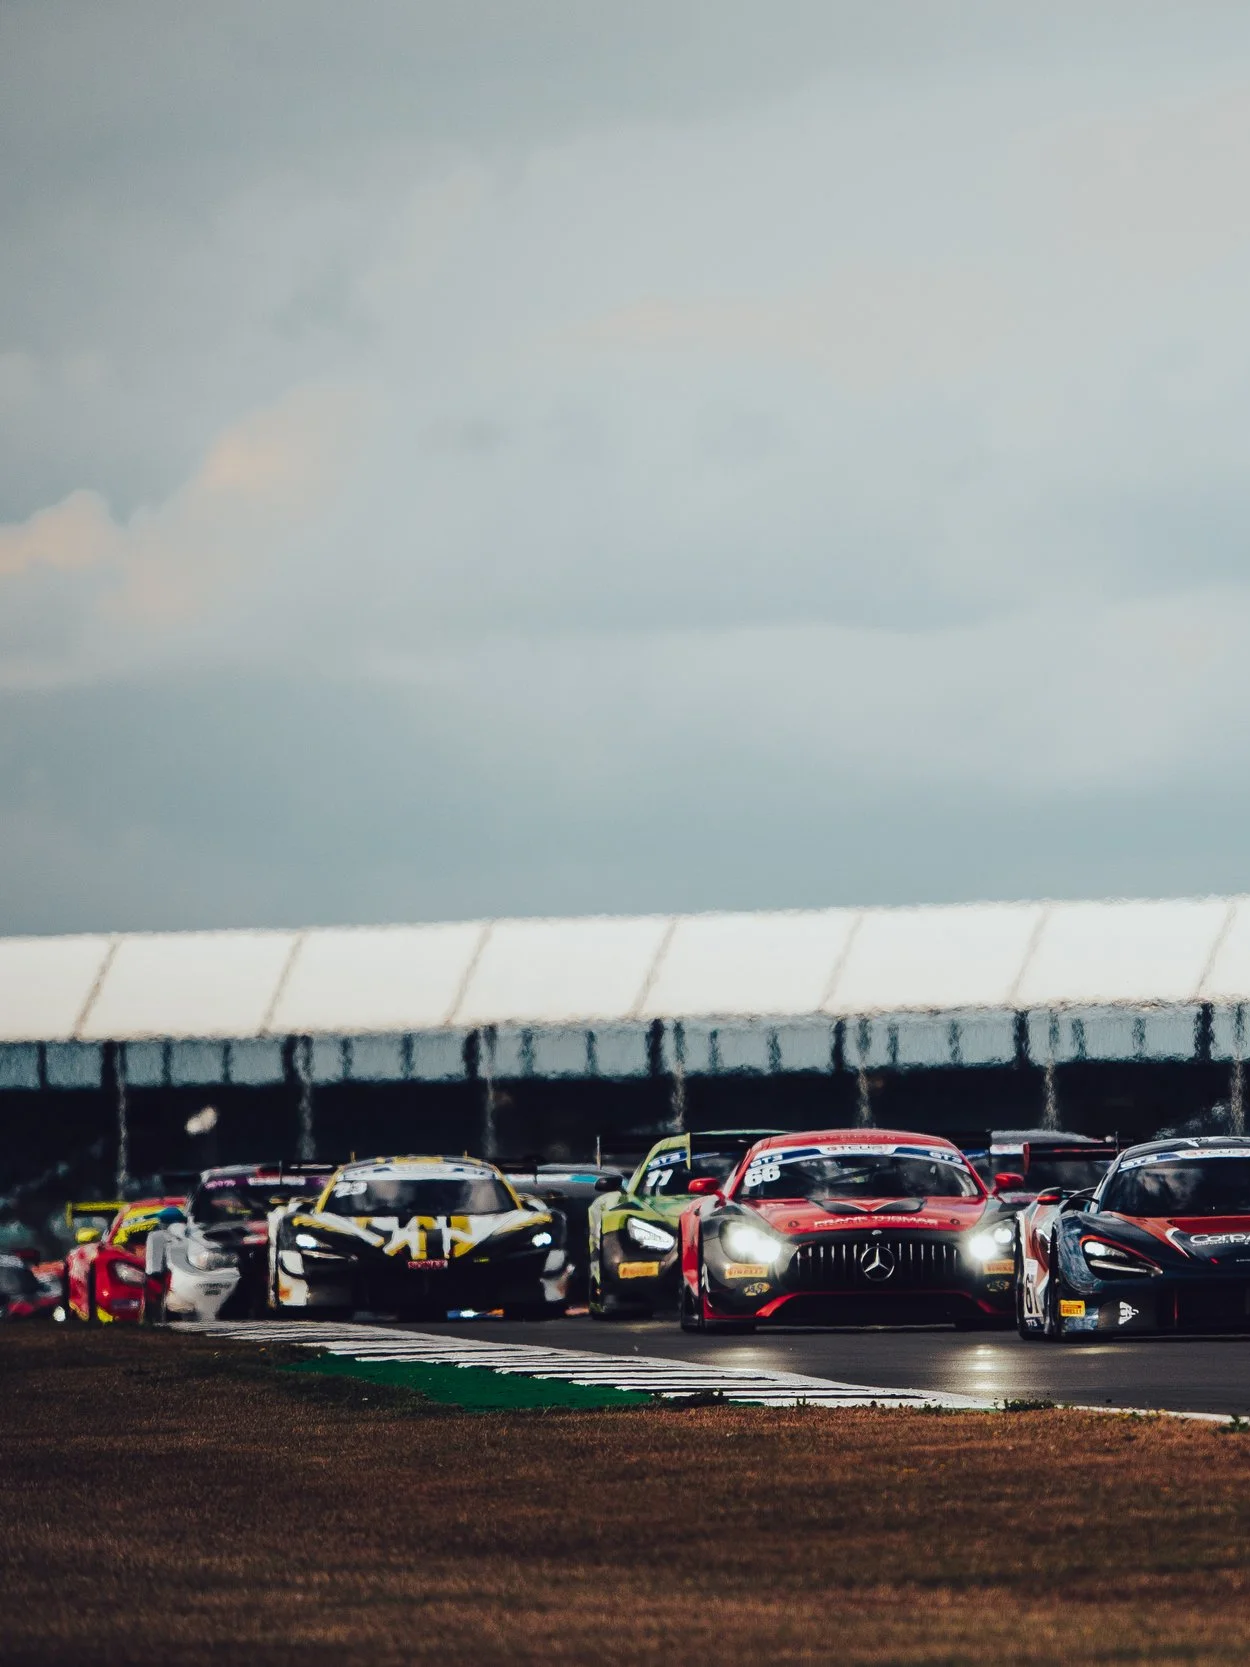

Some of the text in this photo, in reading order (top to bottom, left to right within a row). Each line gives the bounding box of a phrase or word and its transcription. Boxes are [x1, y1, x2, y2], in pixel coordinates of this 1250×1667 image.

[751, 1154, 783, 1167] GT3
[646, 1169, 673, 1187] 11
[744, 1165, 781, 1187] 66
[814, 1215, 938, 1227] FRANK THOMAS
